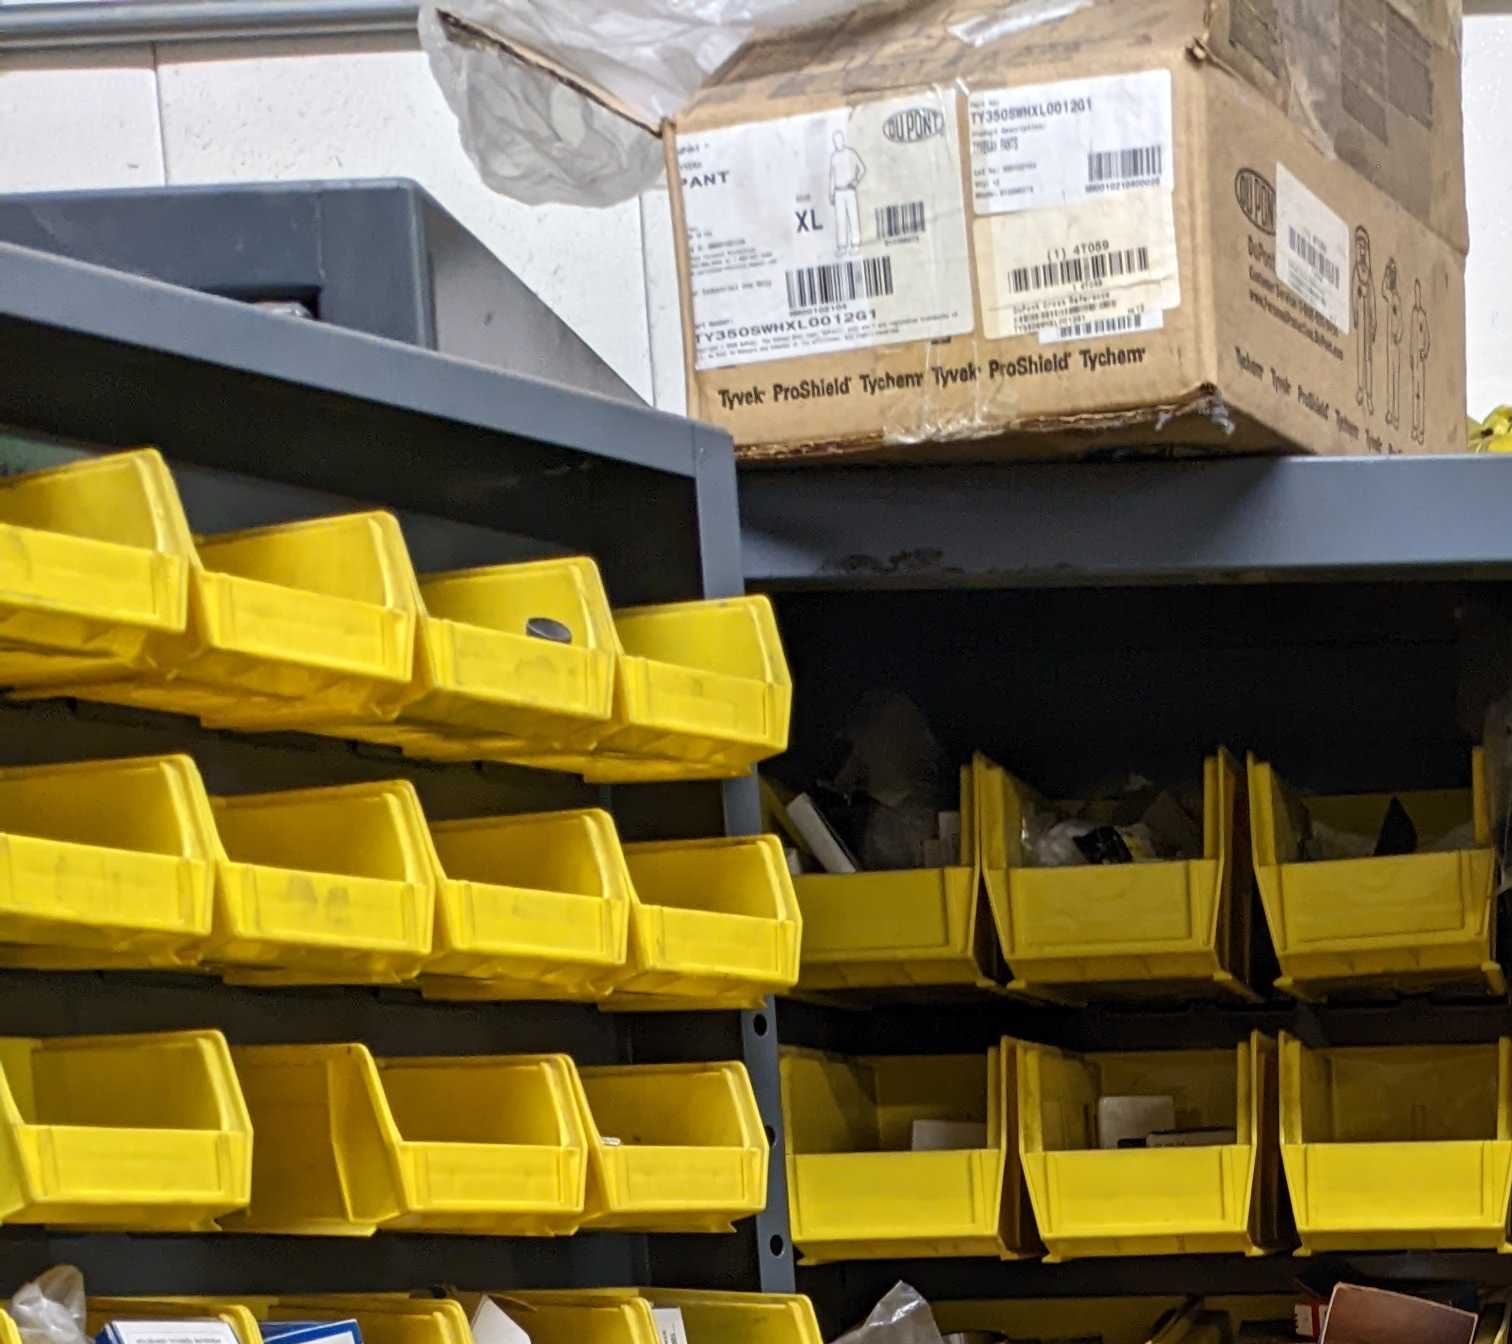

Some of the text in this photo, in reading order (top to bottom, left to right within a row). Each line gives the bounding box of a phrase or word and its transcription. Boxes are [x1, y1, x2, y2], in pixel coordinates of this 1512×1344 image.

[795, 208, 823, 233] XL
[718, 347, 1146, 410] Tyvek ProShield Tychem Tyvek ProShield Tychem
